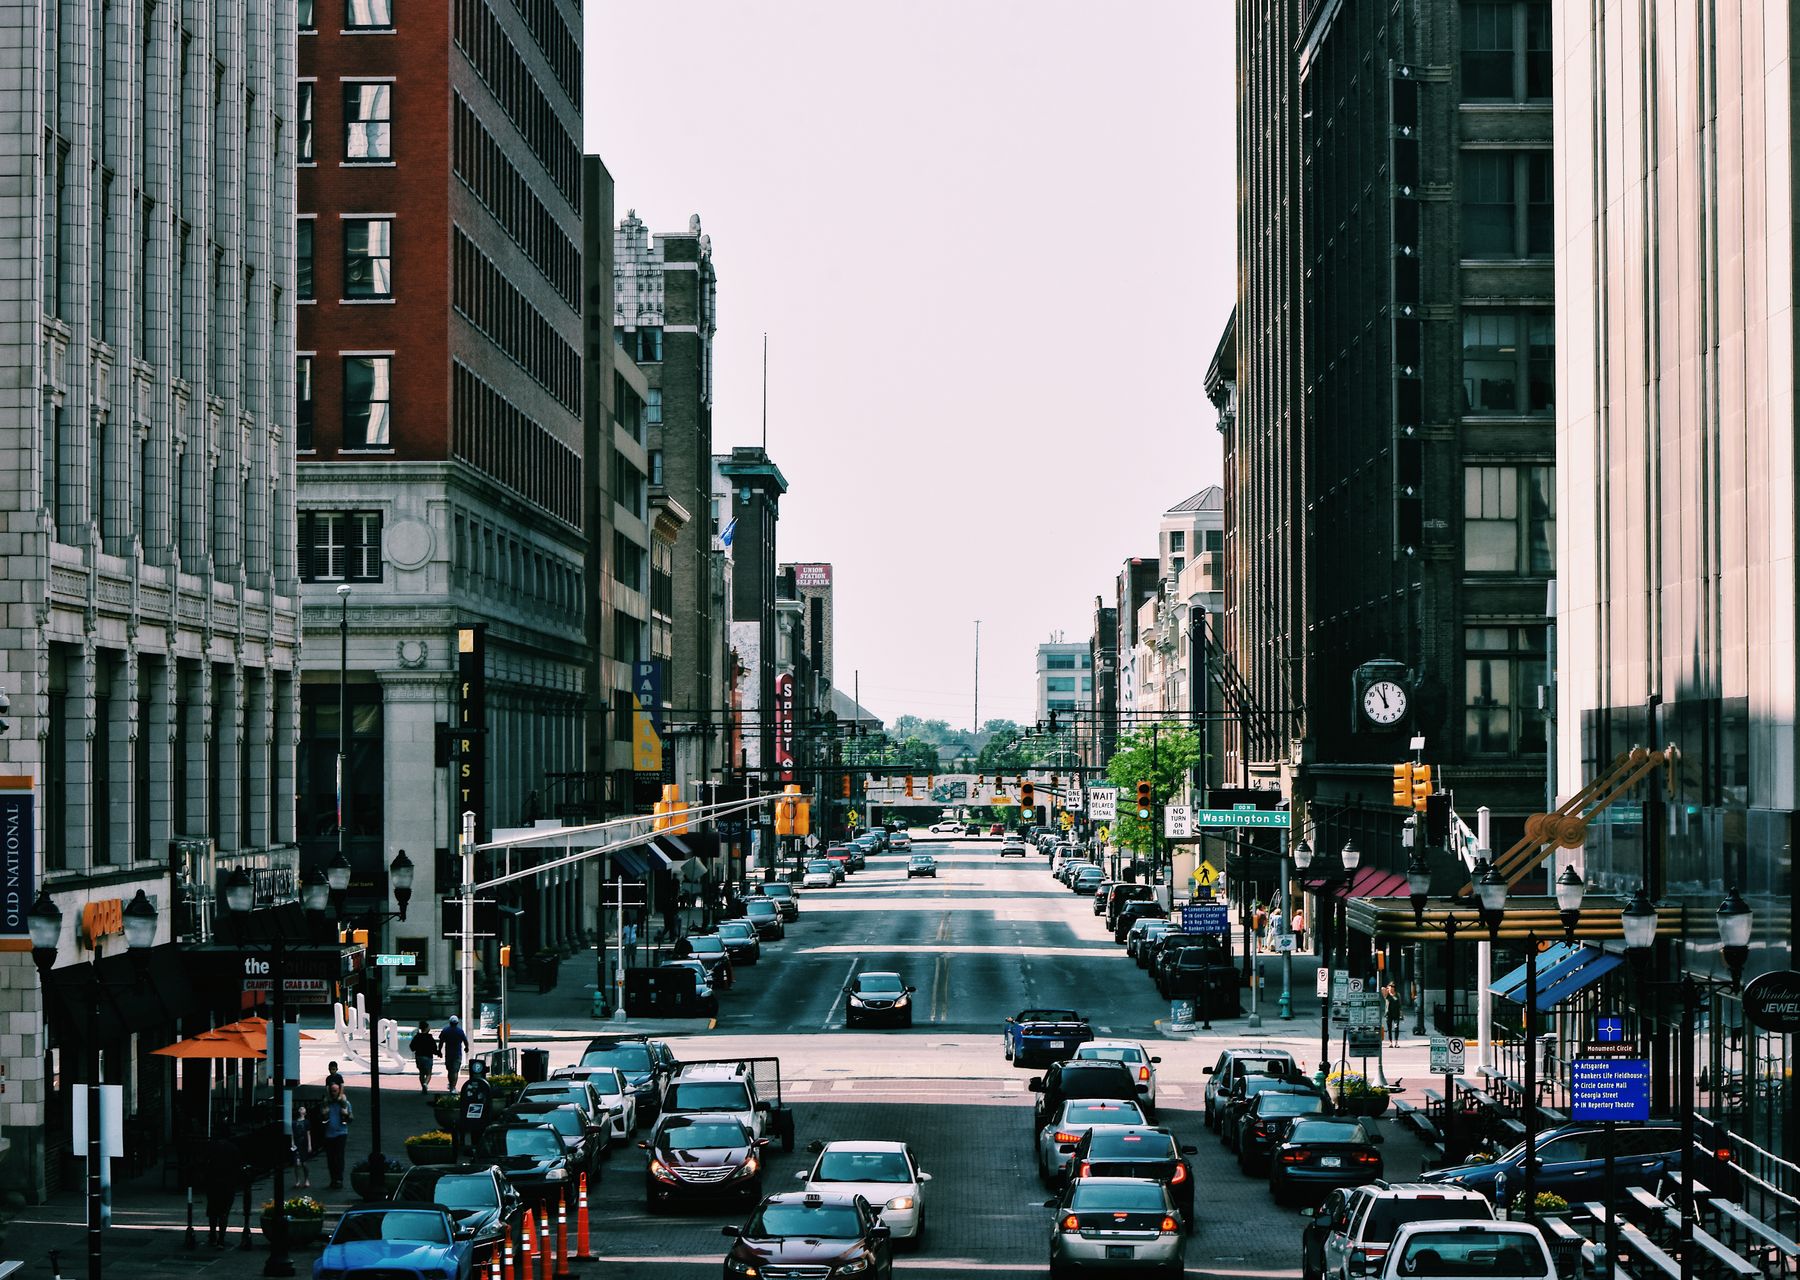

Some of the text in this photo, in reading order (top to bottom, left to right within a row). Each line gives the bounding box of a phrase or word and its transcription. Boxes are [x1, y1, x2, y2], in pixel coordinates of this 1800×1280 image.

[1092, 792, 1114, 800] WAIT
[1203, 814, 1286, 824] Washington St
[7, 804, 19, 926] OLD NATIONAL
[244, 958, 270, 974] the
[284, 981, 302, 989] CRAB
[310, 981, 324, 989] BAR
